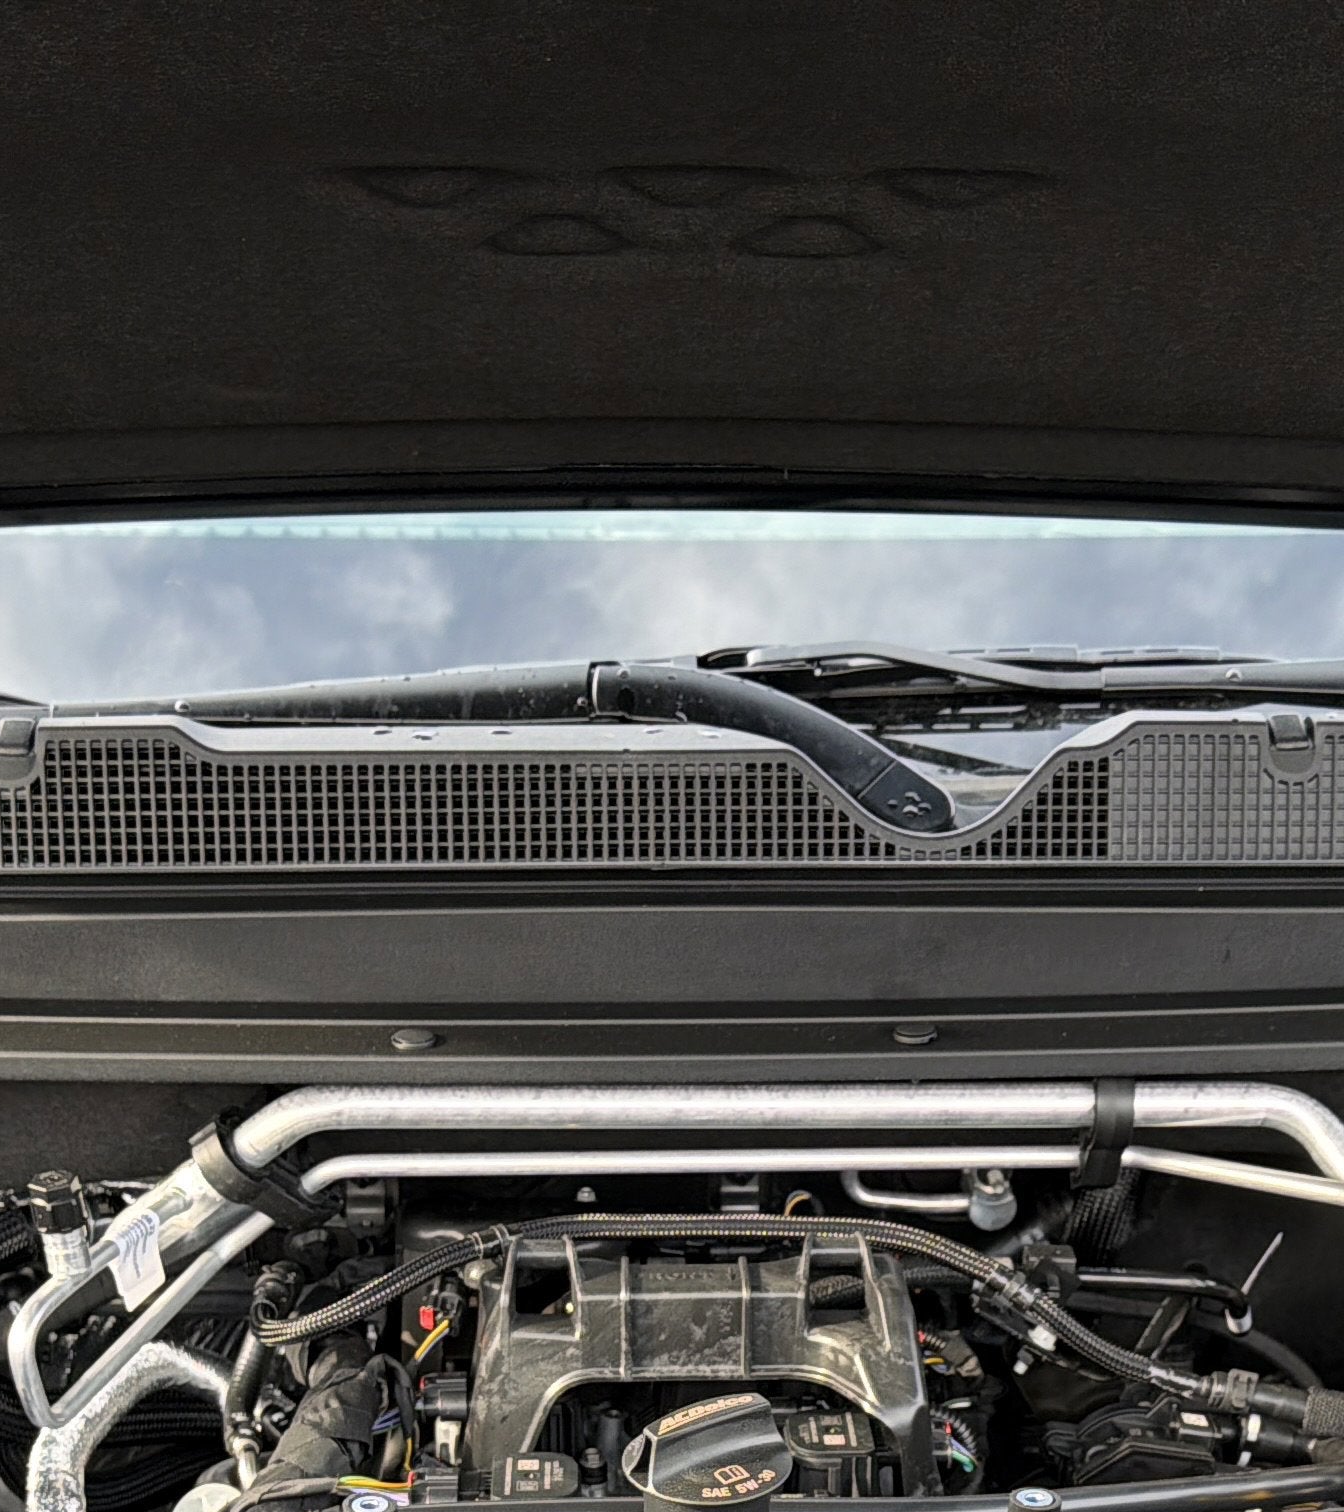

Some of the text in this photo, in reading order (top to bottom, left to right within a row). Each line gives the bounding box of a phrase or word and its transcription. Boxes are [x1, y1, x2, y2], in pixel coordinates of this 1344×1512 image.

[659, 1395, 753, 1432] ACDelco
[702, 1469, 777, 1499] SAE 5W-30
